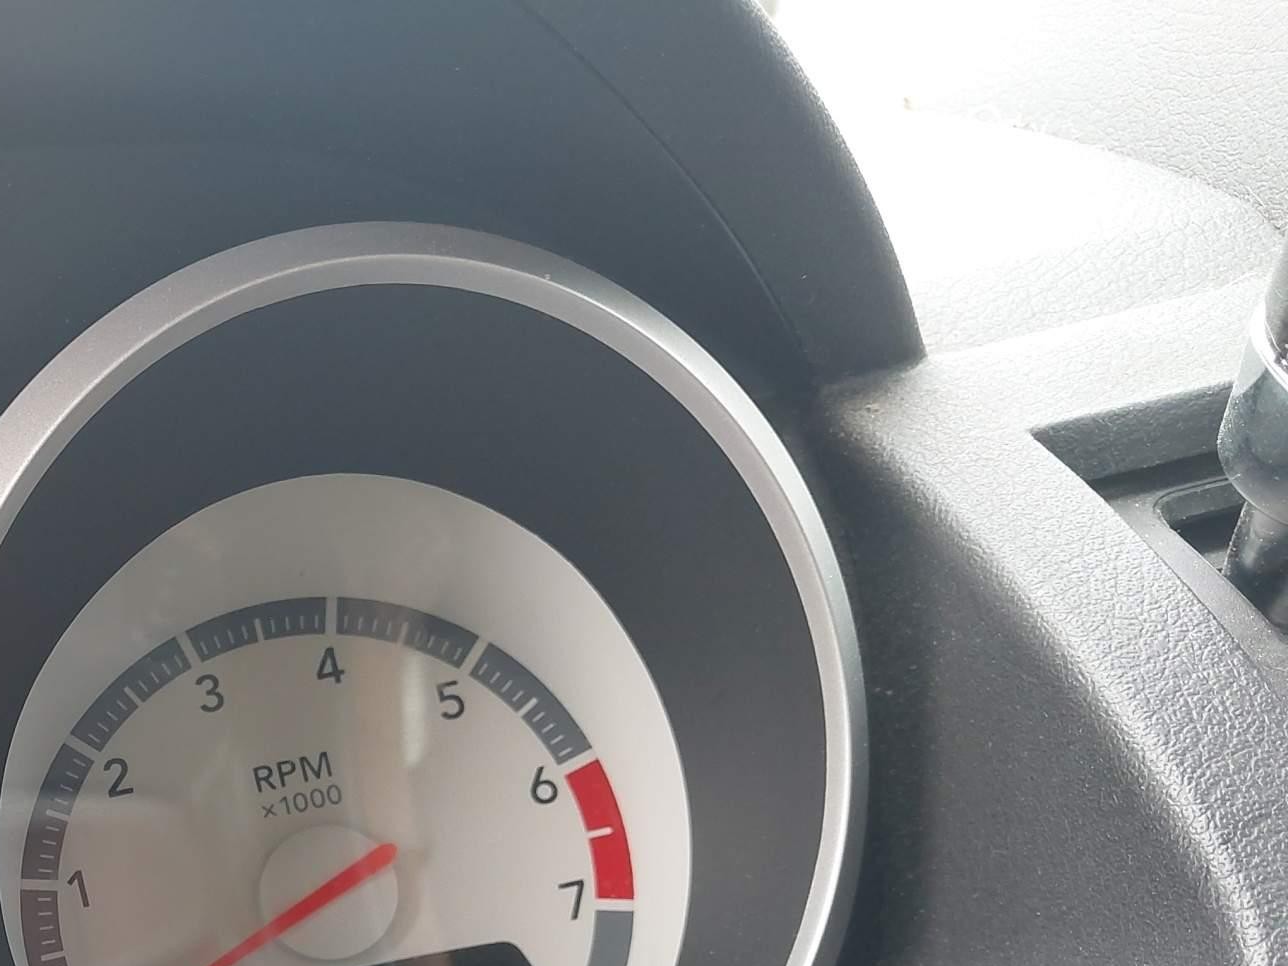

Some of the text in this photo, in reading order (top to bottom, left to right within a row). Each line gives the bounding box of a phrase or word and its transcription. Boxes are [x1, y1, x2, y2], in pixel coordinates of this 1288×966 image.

[316, 647, 345, 684] 4
[195, 674, 224, 713] 3
[436, 680, 465, 720] 5
[103, 757, 135, 798] 2
[252, 751, 333, 792] RPM
[530, 766, 558, 805] 6
[67, 870, 90, 908] 1
[558, 879, 584, 921] 7
